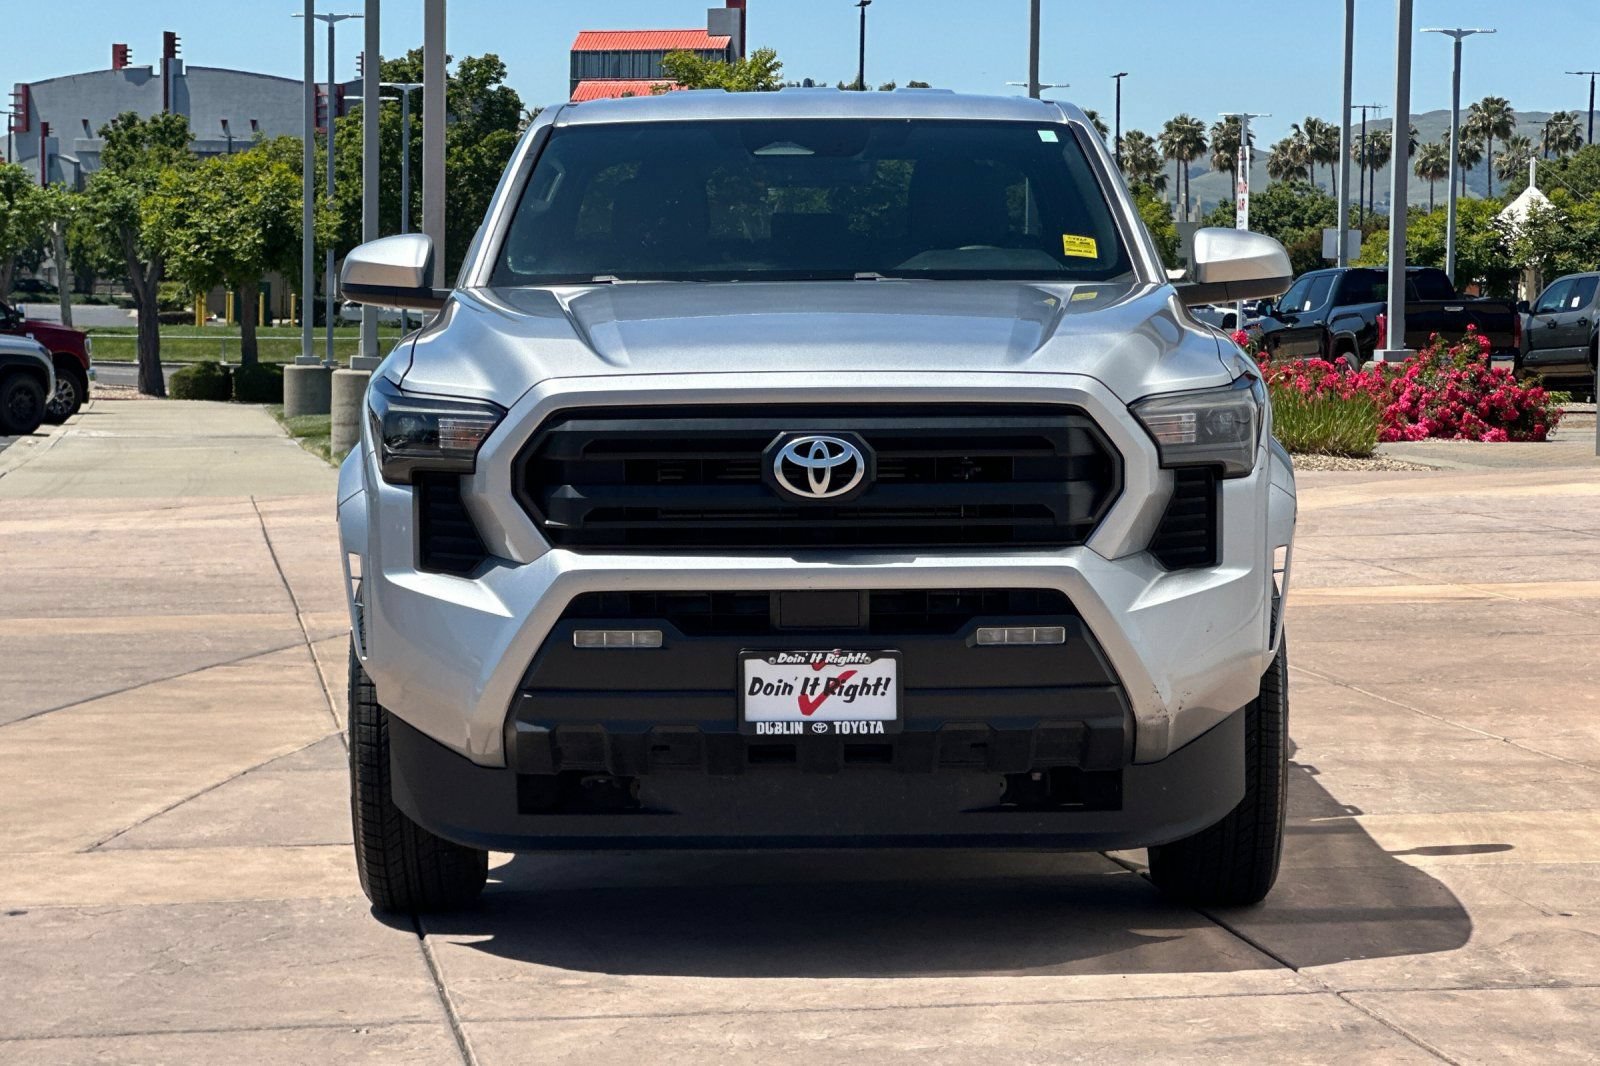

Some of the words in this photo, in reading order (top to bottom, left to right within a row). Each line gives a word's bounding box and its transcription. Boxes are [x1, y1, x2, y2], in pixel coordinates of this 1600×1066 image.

[777, 653, 808, 663] Doin'
[810, 653, 824, 663] It
[825, 652, 865, 666] Right!
[748, 676, 798, 696] Doin'
[800, 677, 820, 696] It
[823, 677, 891, 703] Right!
[756, 722, 803, 734] DUBLIN
[833, 721, 884, 734] TOYOTA
